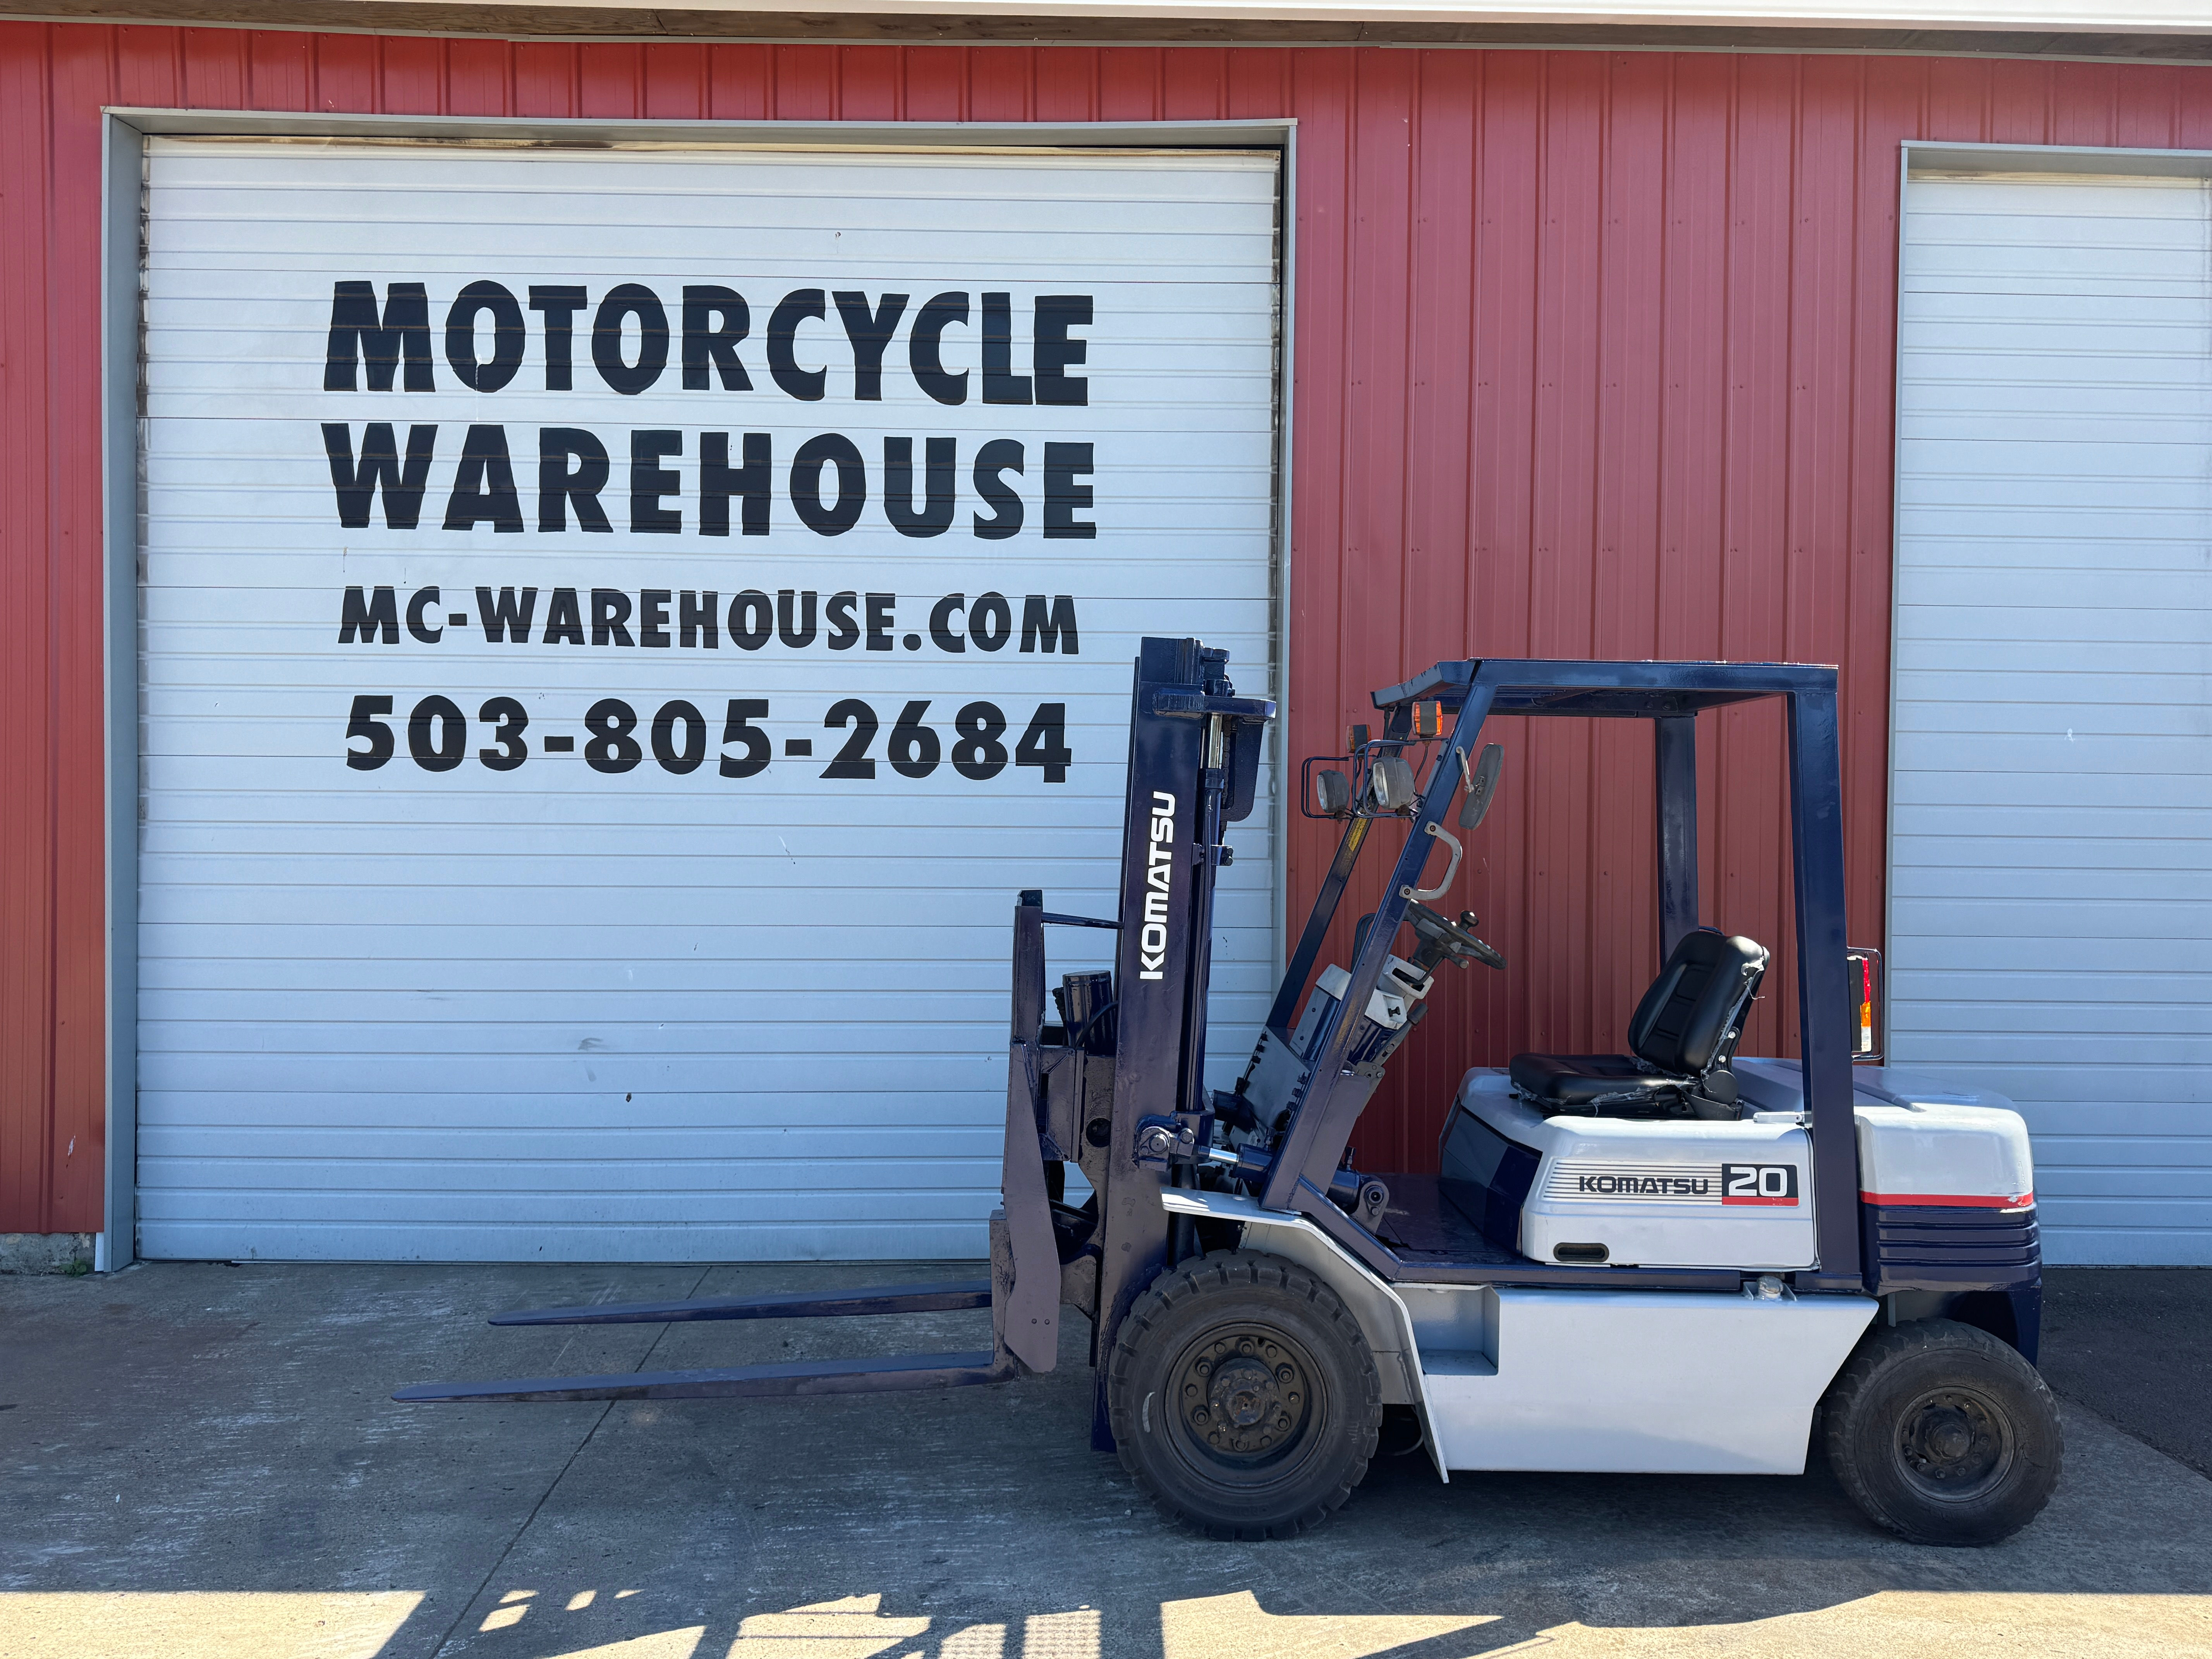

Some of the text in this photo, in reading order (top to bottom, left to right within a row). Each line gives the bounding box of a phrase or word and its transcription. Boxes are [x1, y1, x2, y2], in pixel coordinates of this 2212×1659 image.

[324, 280, 1093, 406] MOTORCYCLE
[321, 423, 1096, 539] WAREHOUSE
[338, 586, 1079, 654] MC-WAREHOUSE.COM
[346, 695, 1072, 783] 503-805-2684
[1140, 791, 1176, 980] KOMATSU
[1579, 1167, 1788, 1197] KOMATSU 20
